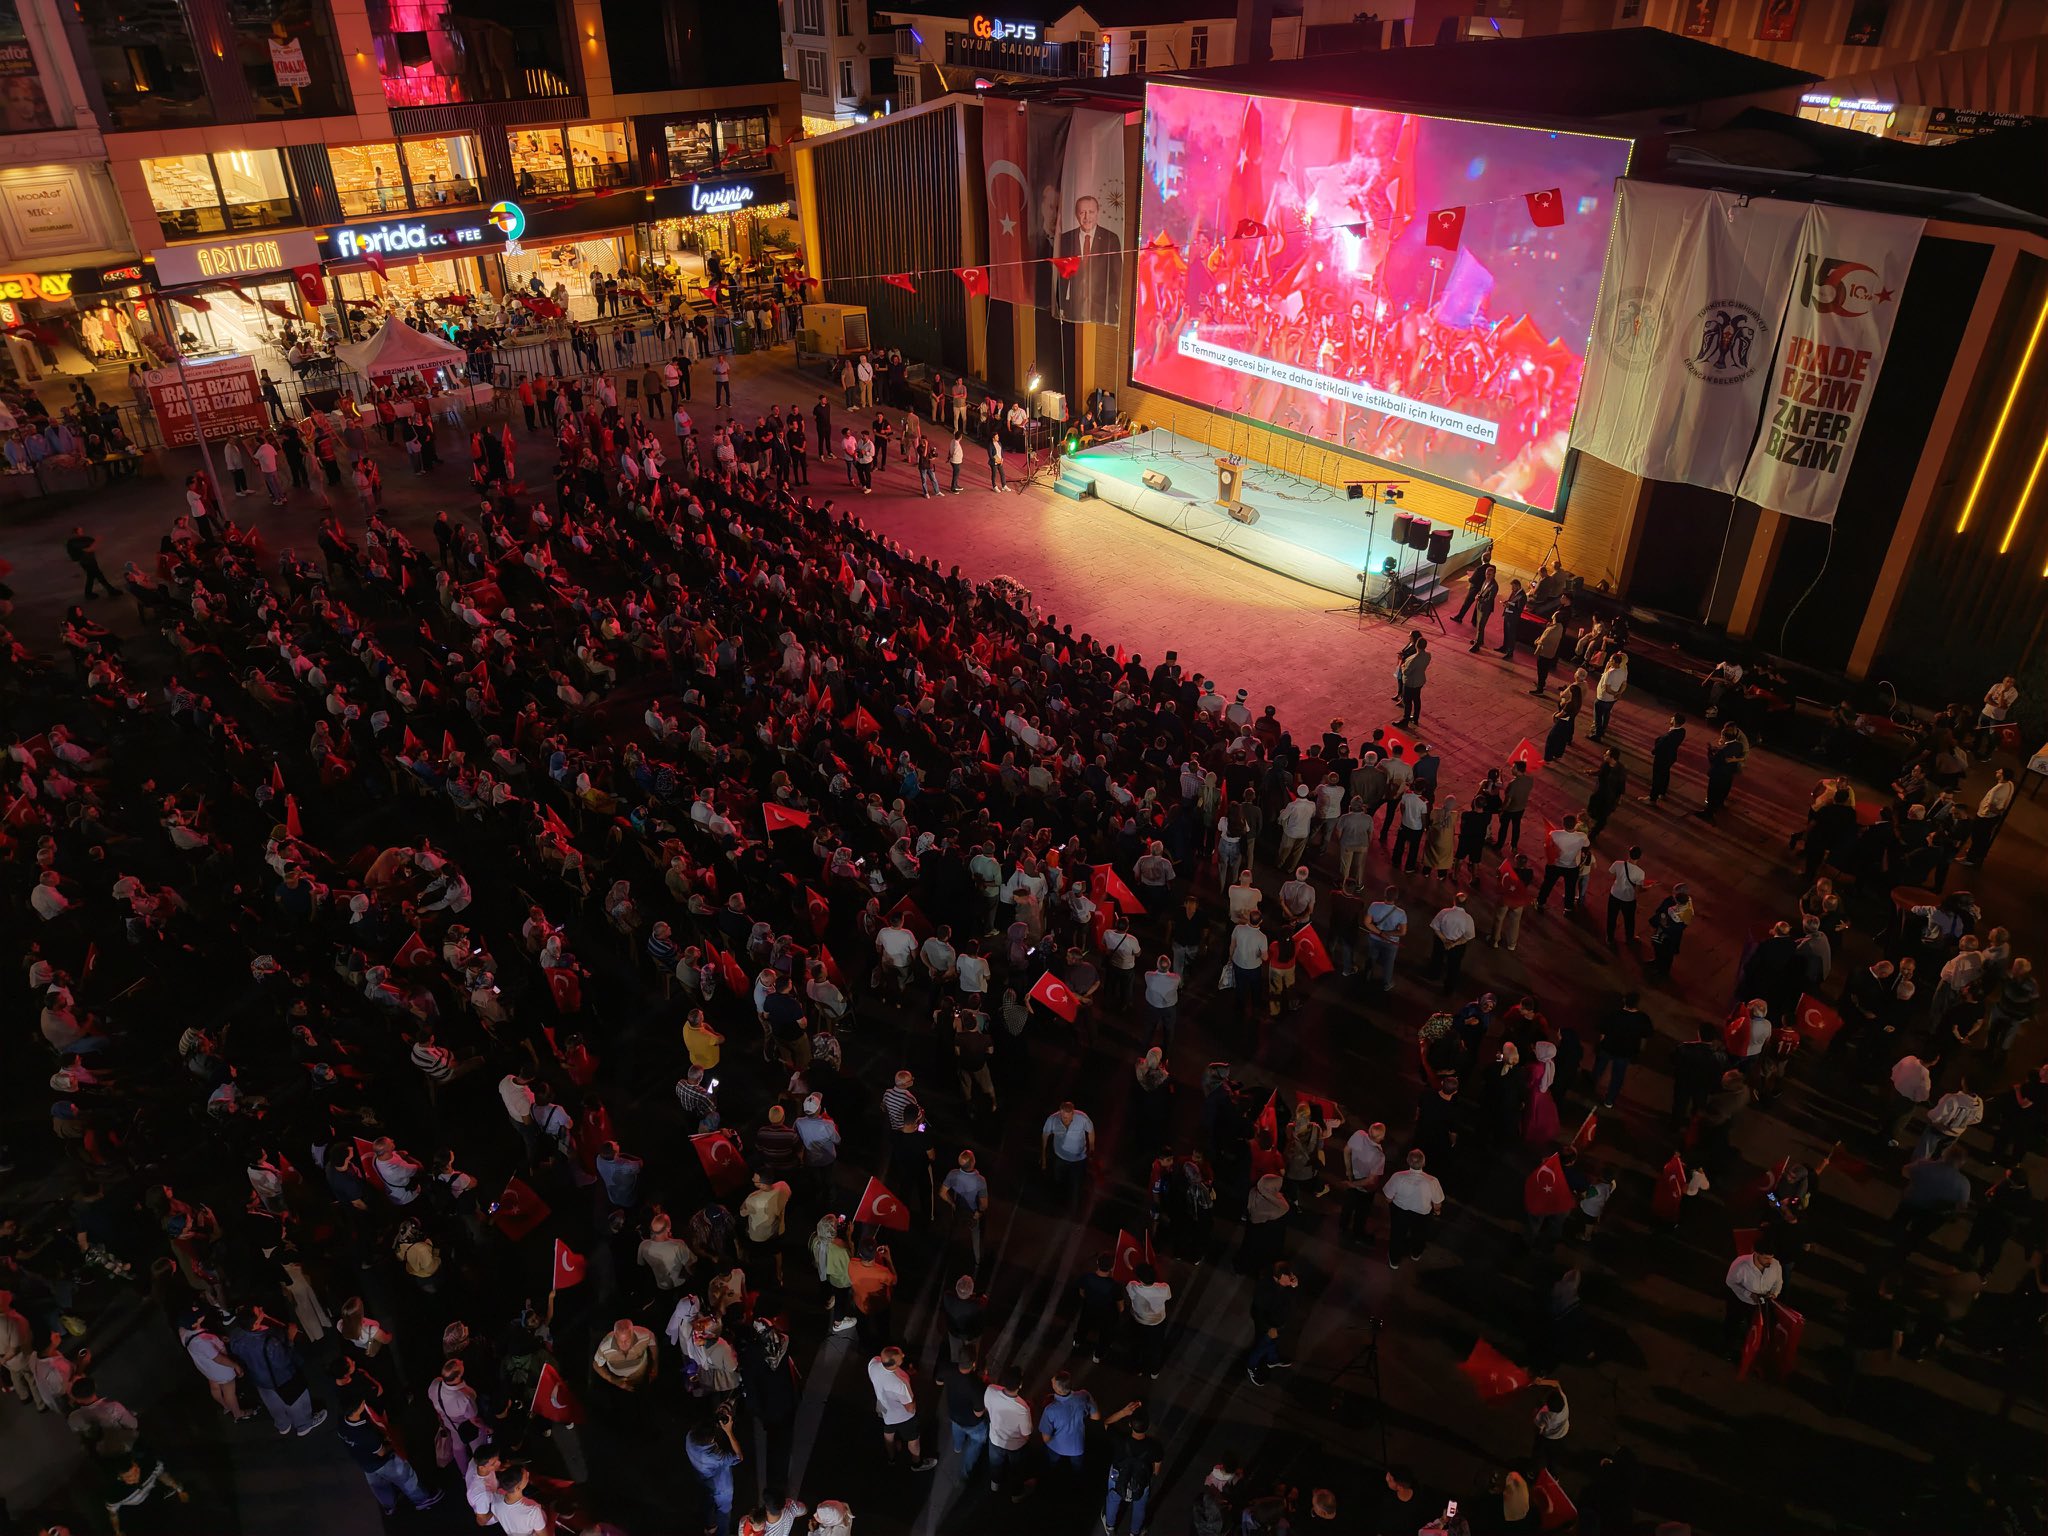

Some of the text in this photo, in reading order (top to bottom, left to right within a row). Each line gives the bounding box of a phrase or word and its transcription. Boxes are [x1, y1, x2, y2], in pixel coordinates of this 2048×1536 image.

[974, 15, 1036, 40] GG PS5
[961, 38, 1049, 58] OYUN SALONU
[692, 184, 754, 211] Lavinia
[338, 224, 481, 257] florida COFEE
[197, 240, 283, 276] ARTIZAN
[206, 374, 250, 394] BİZİM
[212, 390, 254, 410] BİZİM
[1181, 340, 1494, 439] 15 Temmuz gecesi bir kez daha istiklali ve istikbali için kıyam eden
[1780, 366, 1862, 413] BİZİM
[1773, 398, 1851, 443] ZAFER
[1765, 426, 1843, 474] BİZİM
